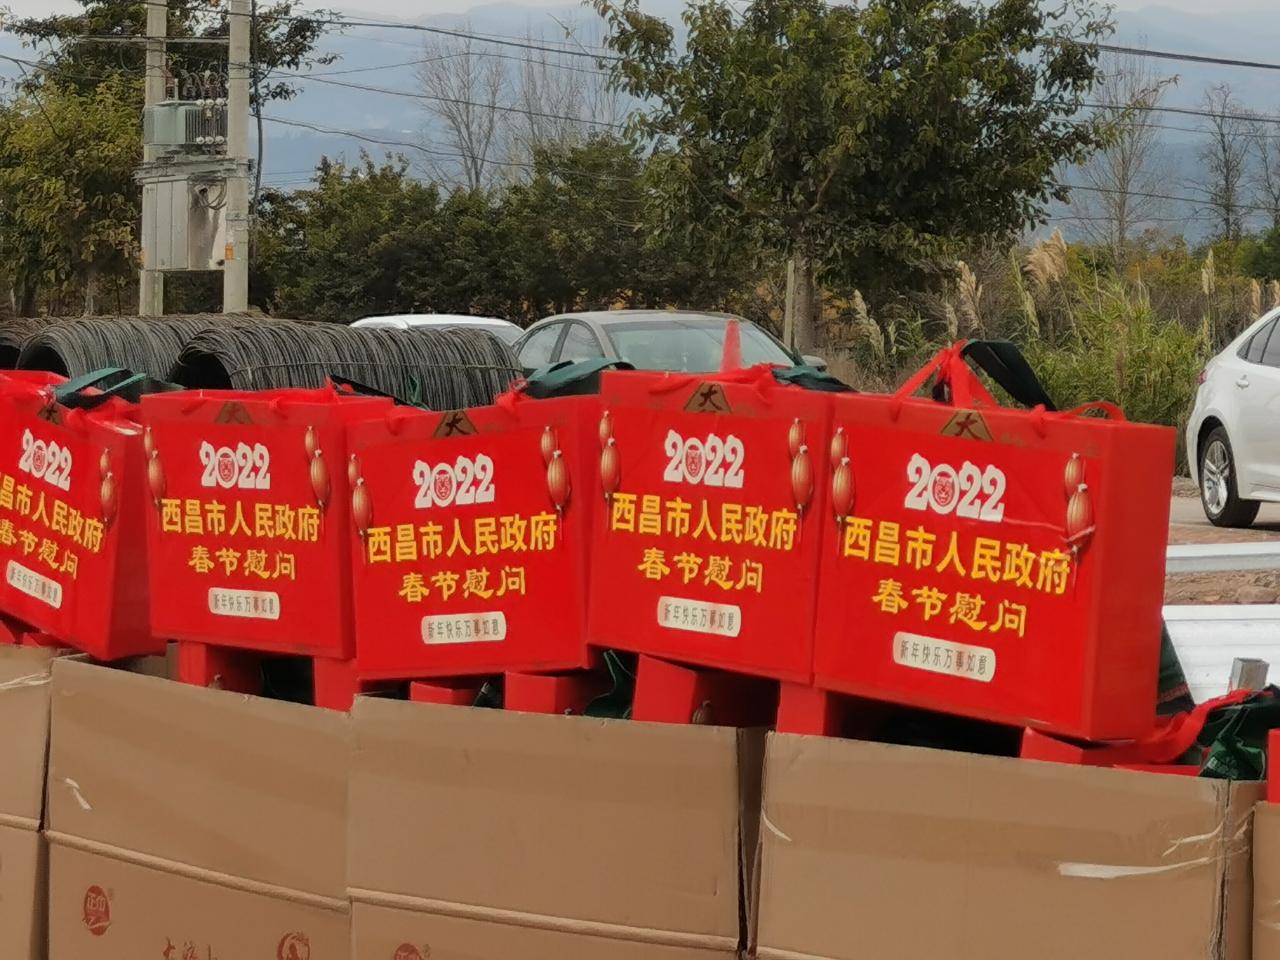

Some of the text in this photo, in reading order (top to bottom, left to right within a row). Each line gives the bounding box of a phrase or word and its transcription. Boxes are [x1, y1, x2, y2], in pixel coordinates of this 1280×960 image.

[19, 428, 72, 492] 2022
[199, 441, 271, 490] 2022
[413, 453, 495, 509] 2022
[663, 430, 744, 488] 2022
[904, 453, 1006, 521] 2022
[0, 474, 104, 553] 昌市人民政府
[162, 498, 320, 542] 西昌市人民政府
[367, 511, 557, 563] 西昌市人民政府
[612, 492, 798, 550] 西昌市人民政府
[188, 545, 295, 580] 春节慰问
[637, 547, 763, 592] 春节慰问
[844, 515, 1071, 594] 西昌市人民政府
[398, 566, 526, 602] 春节慰问
[872, 578, 1027, 637] 春节慰问
